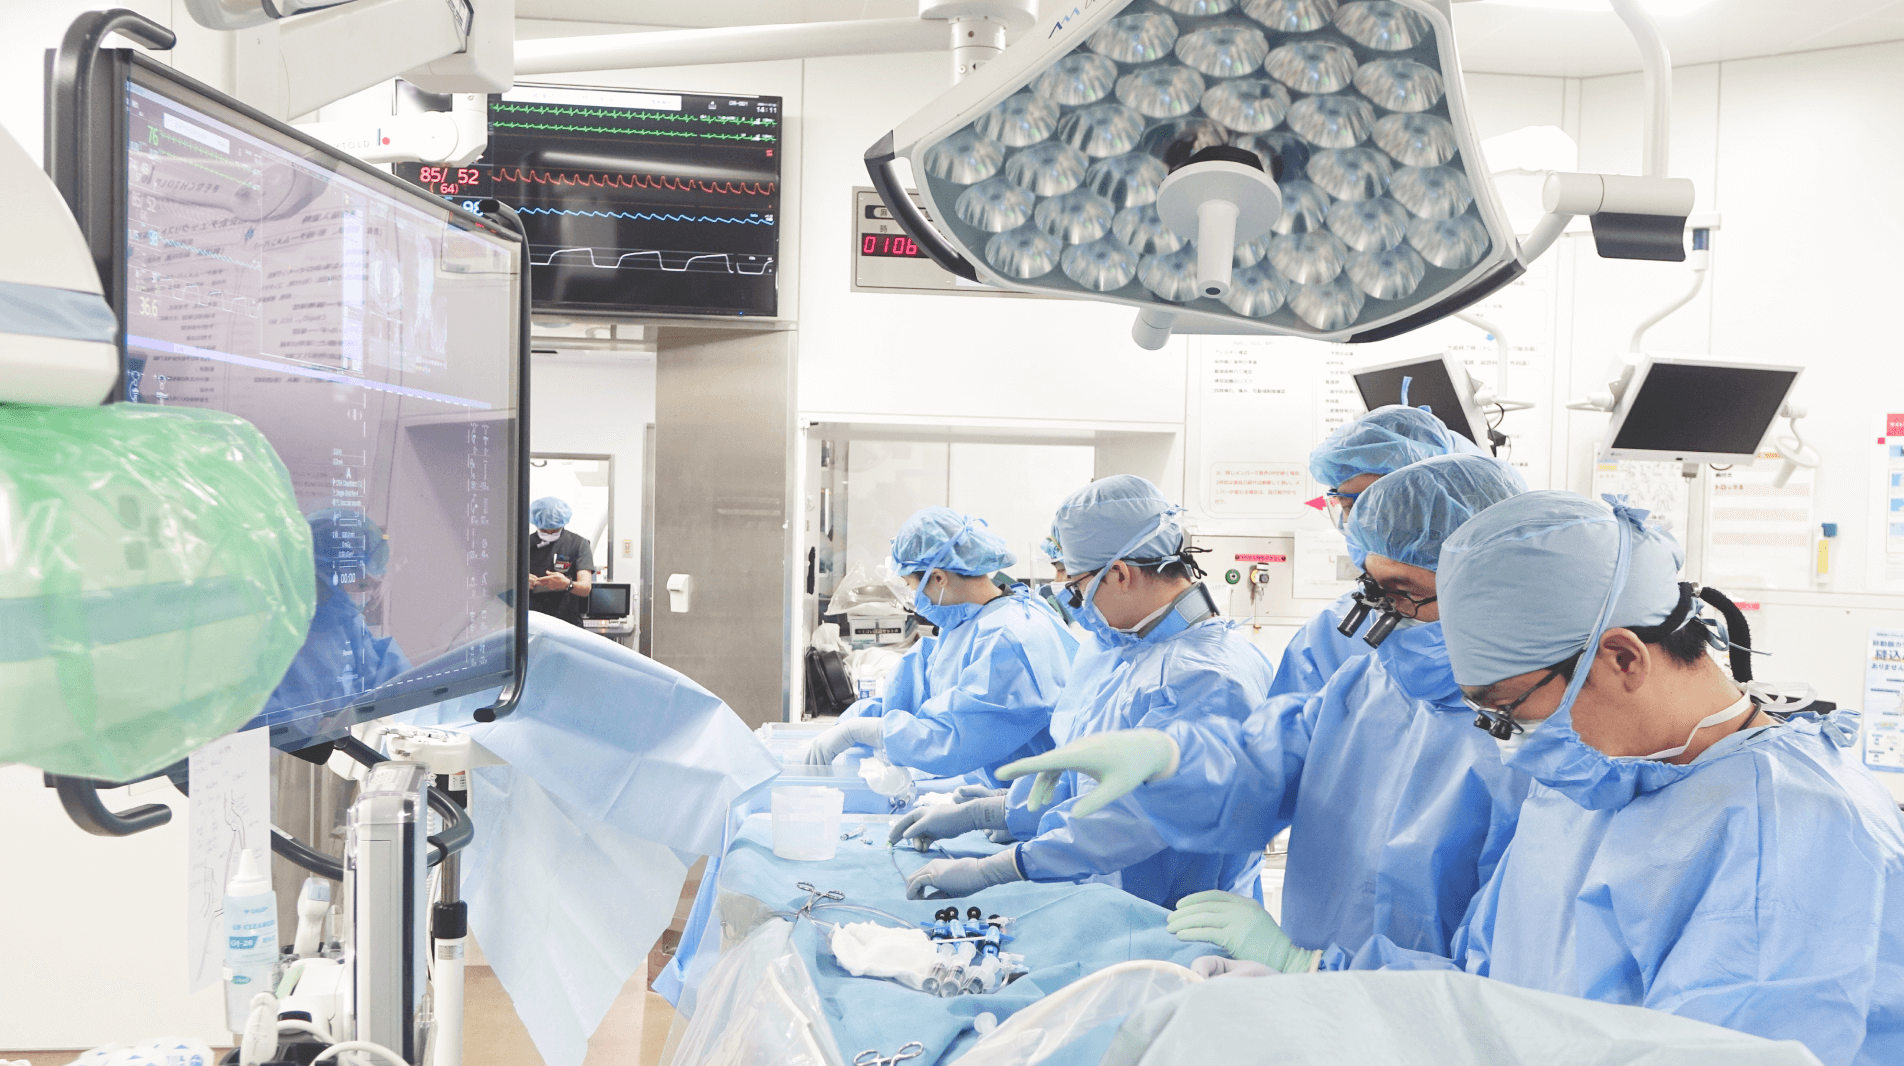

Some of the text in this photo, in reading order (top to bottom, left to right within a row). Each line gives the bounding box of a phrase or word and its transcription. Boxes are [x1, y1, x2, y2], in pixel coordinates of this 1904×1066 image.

[147, 124, 159, 146] 76
[457, 168, 480, 184] 52
[139, 296, 159, 318] 36.6
